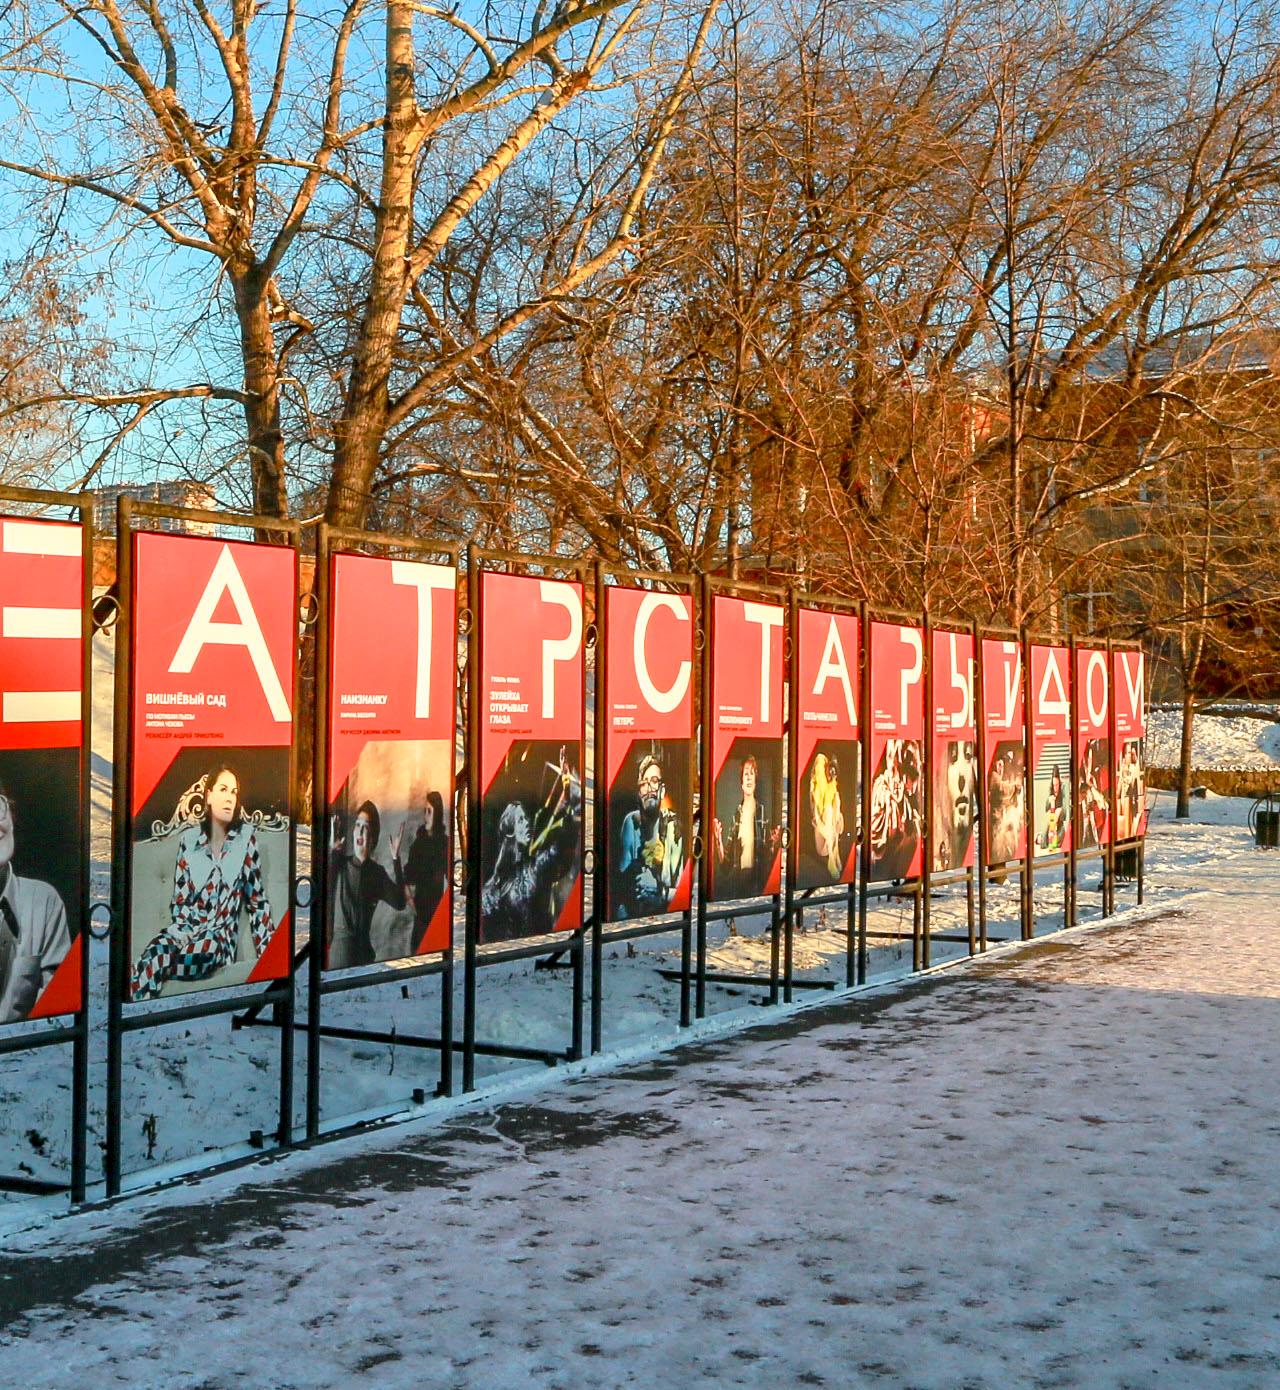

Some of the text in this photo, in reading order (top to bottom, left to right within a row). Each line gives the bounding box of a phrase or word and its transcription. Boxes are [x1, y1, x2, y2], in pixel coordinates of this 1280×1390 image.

[145, 692, 227, 708] ВИШНЁВЫЙ САД
[340, 694, 388, 705] НАИЗНАНКУ
[489, 703, 529, 713] ОТКРЫВАЕТ
[489, 715, 512, 724] ГЛАЗА
